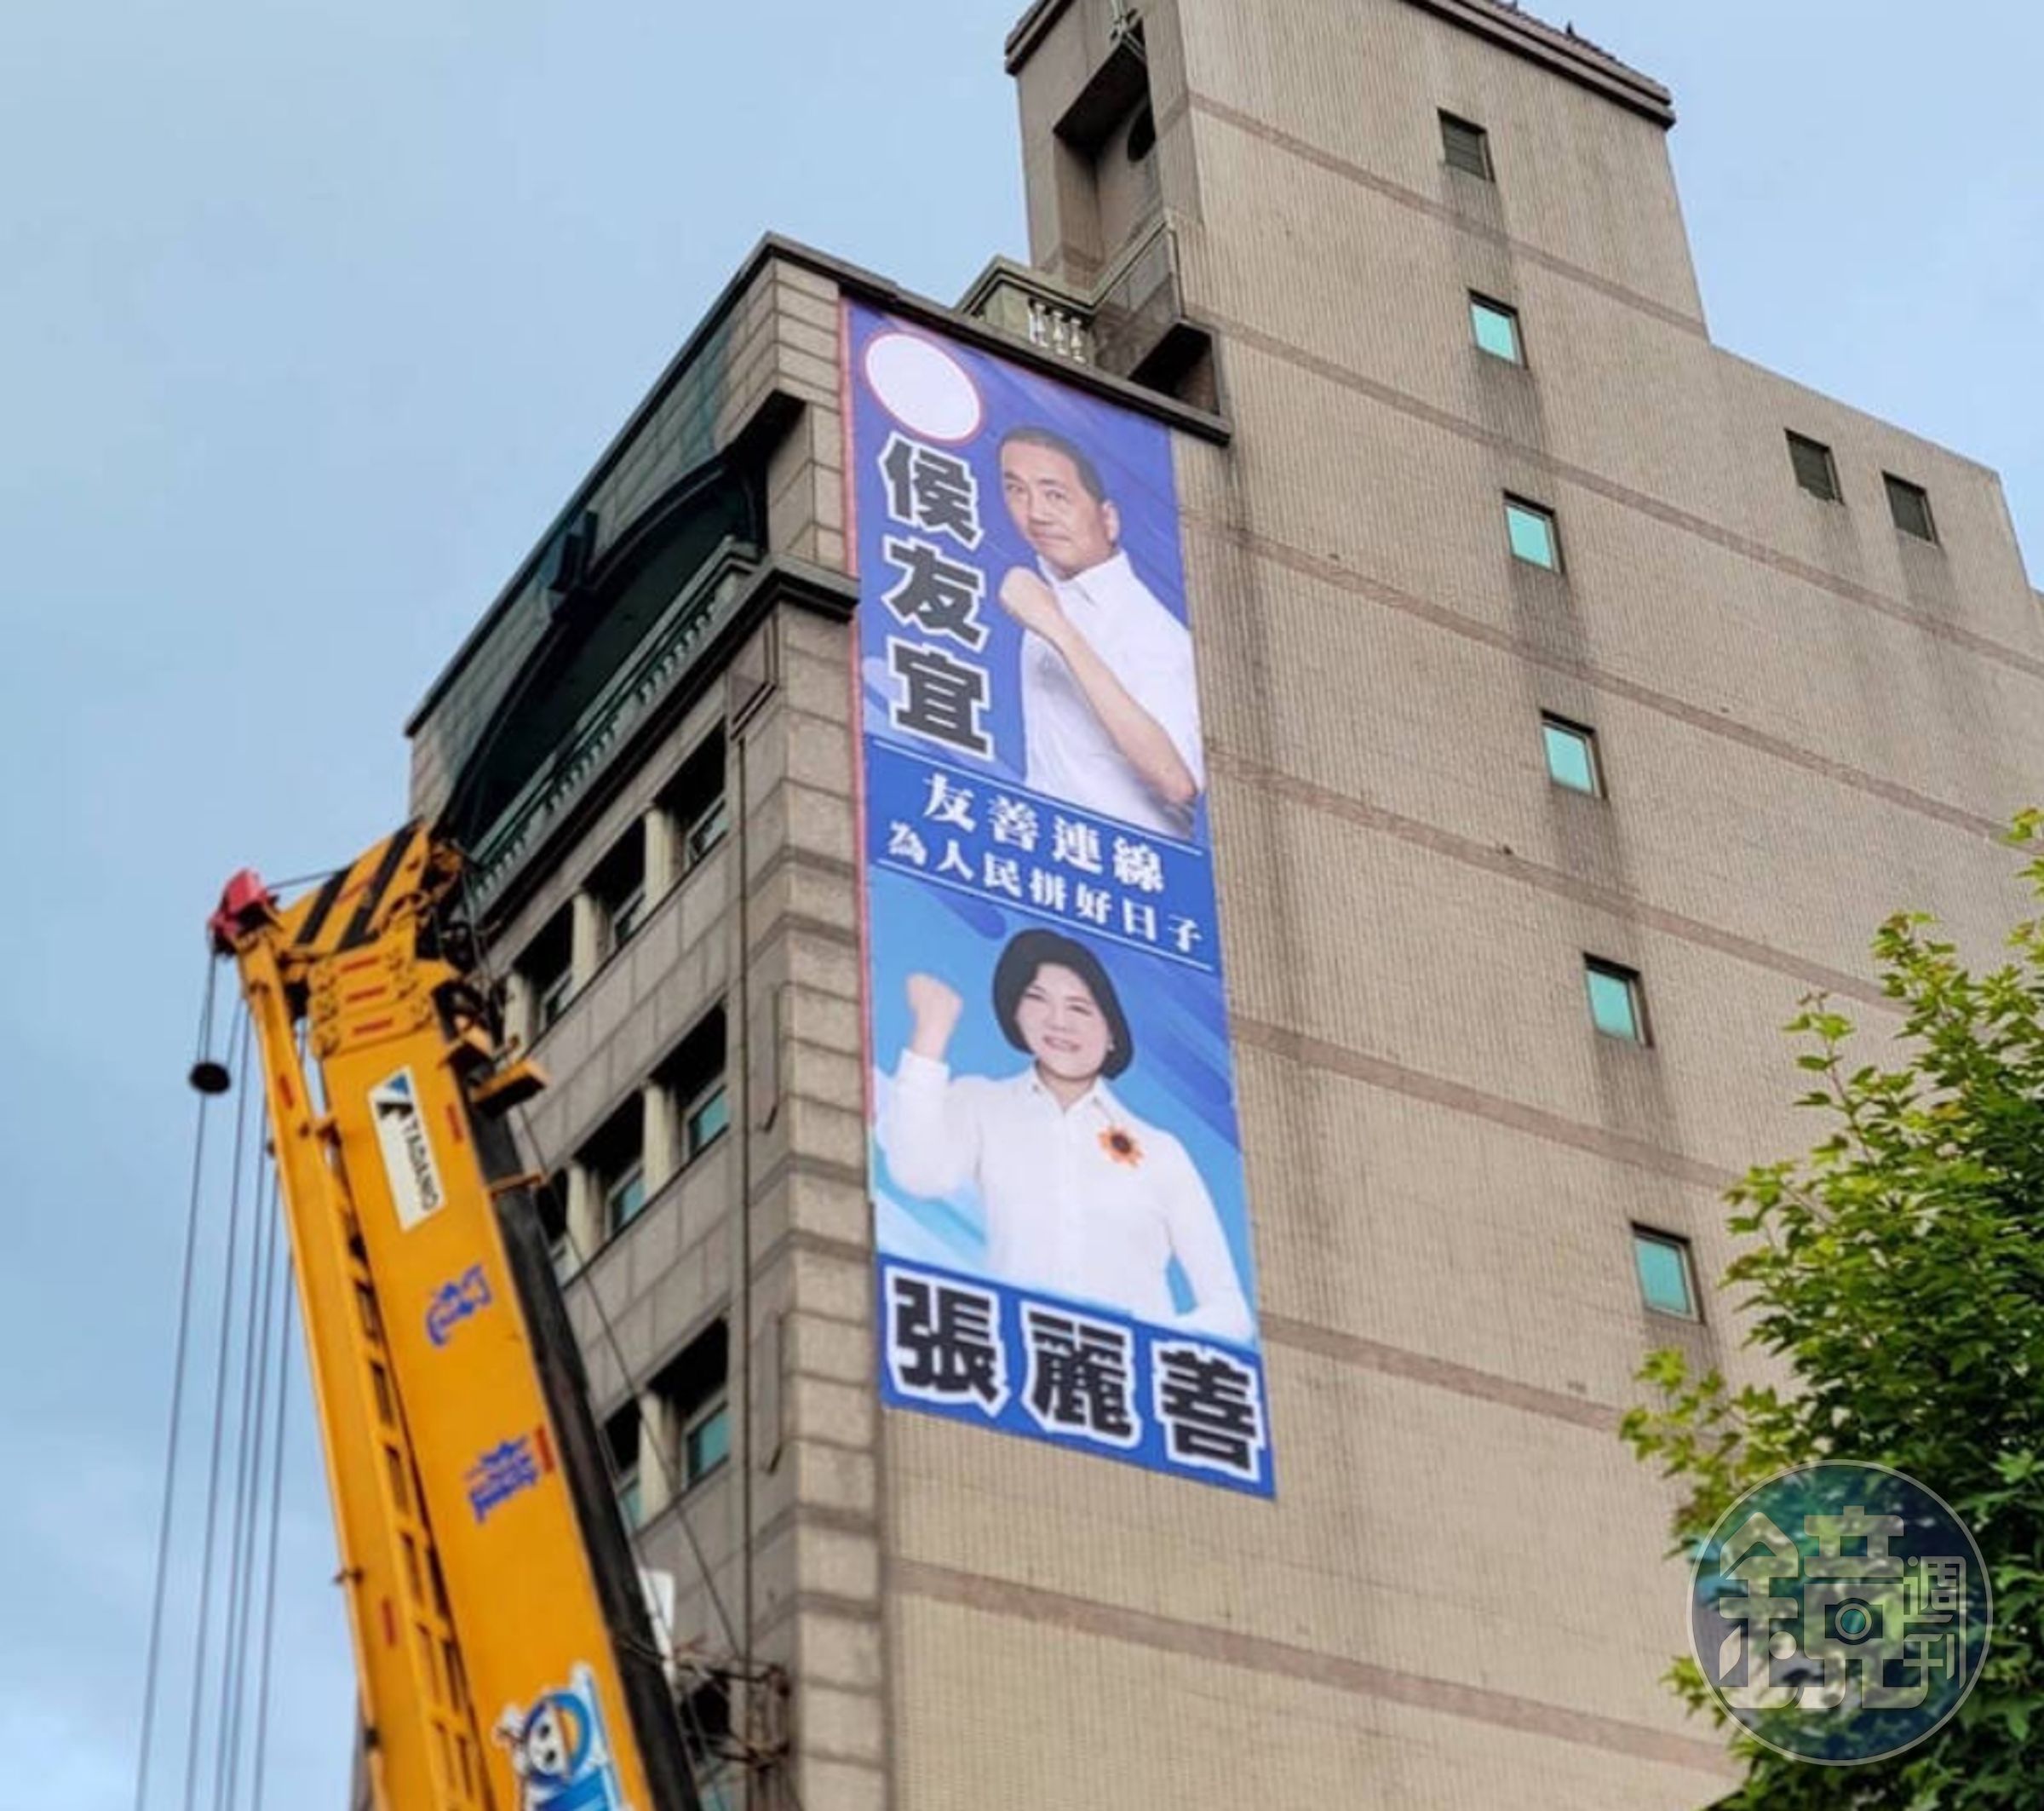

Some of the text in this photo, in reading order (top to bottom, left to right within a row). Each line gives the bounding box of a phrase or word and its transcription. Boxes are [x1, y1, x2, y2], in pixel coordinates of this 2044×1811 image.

[880, 433, 994, 760] 侯友宜
[887, 820, 1202, 952] 為人民拼好日子
[922, 773, 1164, 893] 友善連線
[402, 1117, 439, 1211] TADANO
[885, 1266, 1263, 1480] 張麗善
